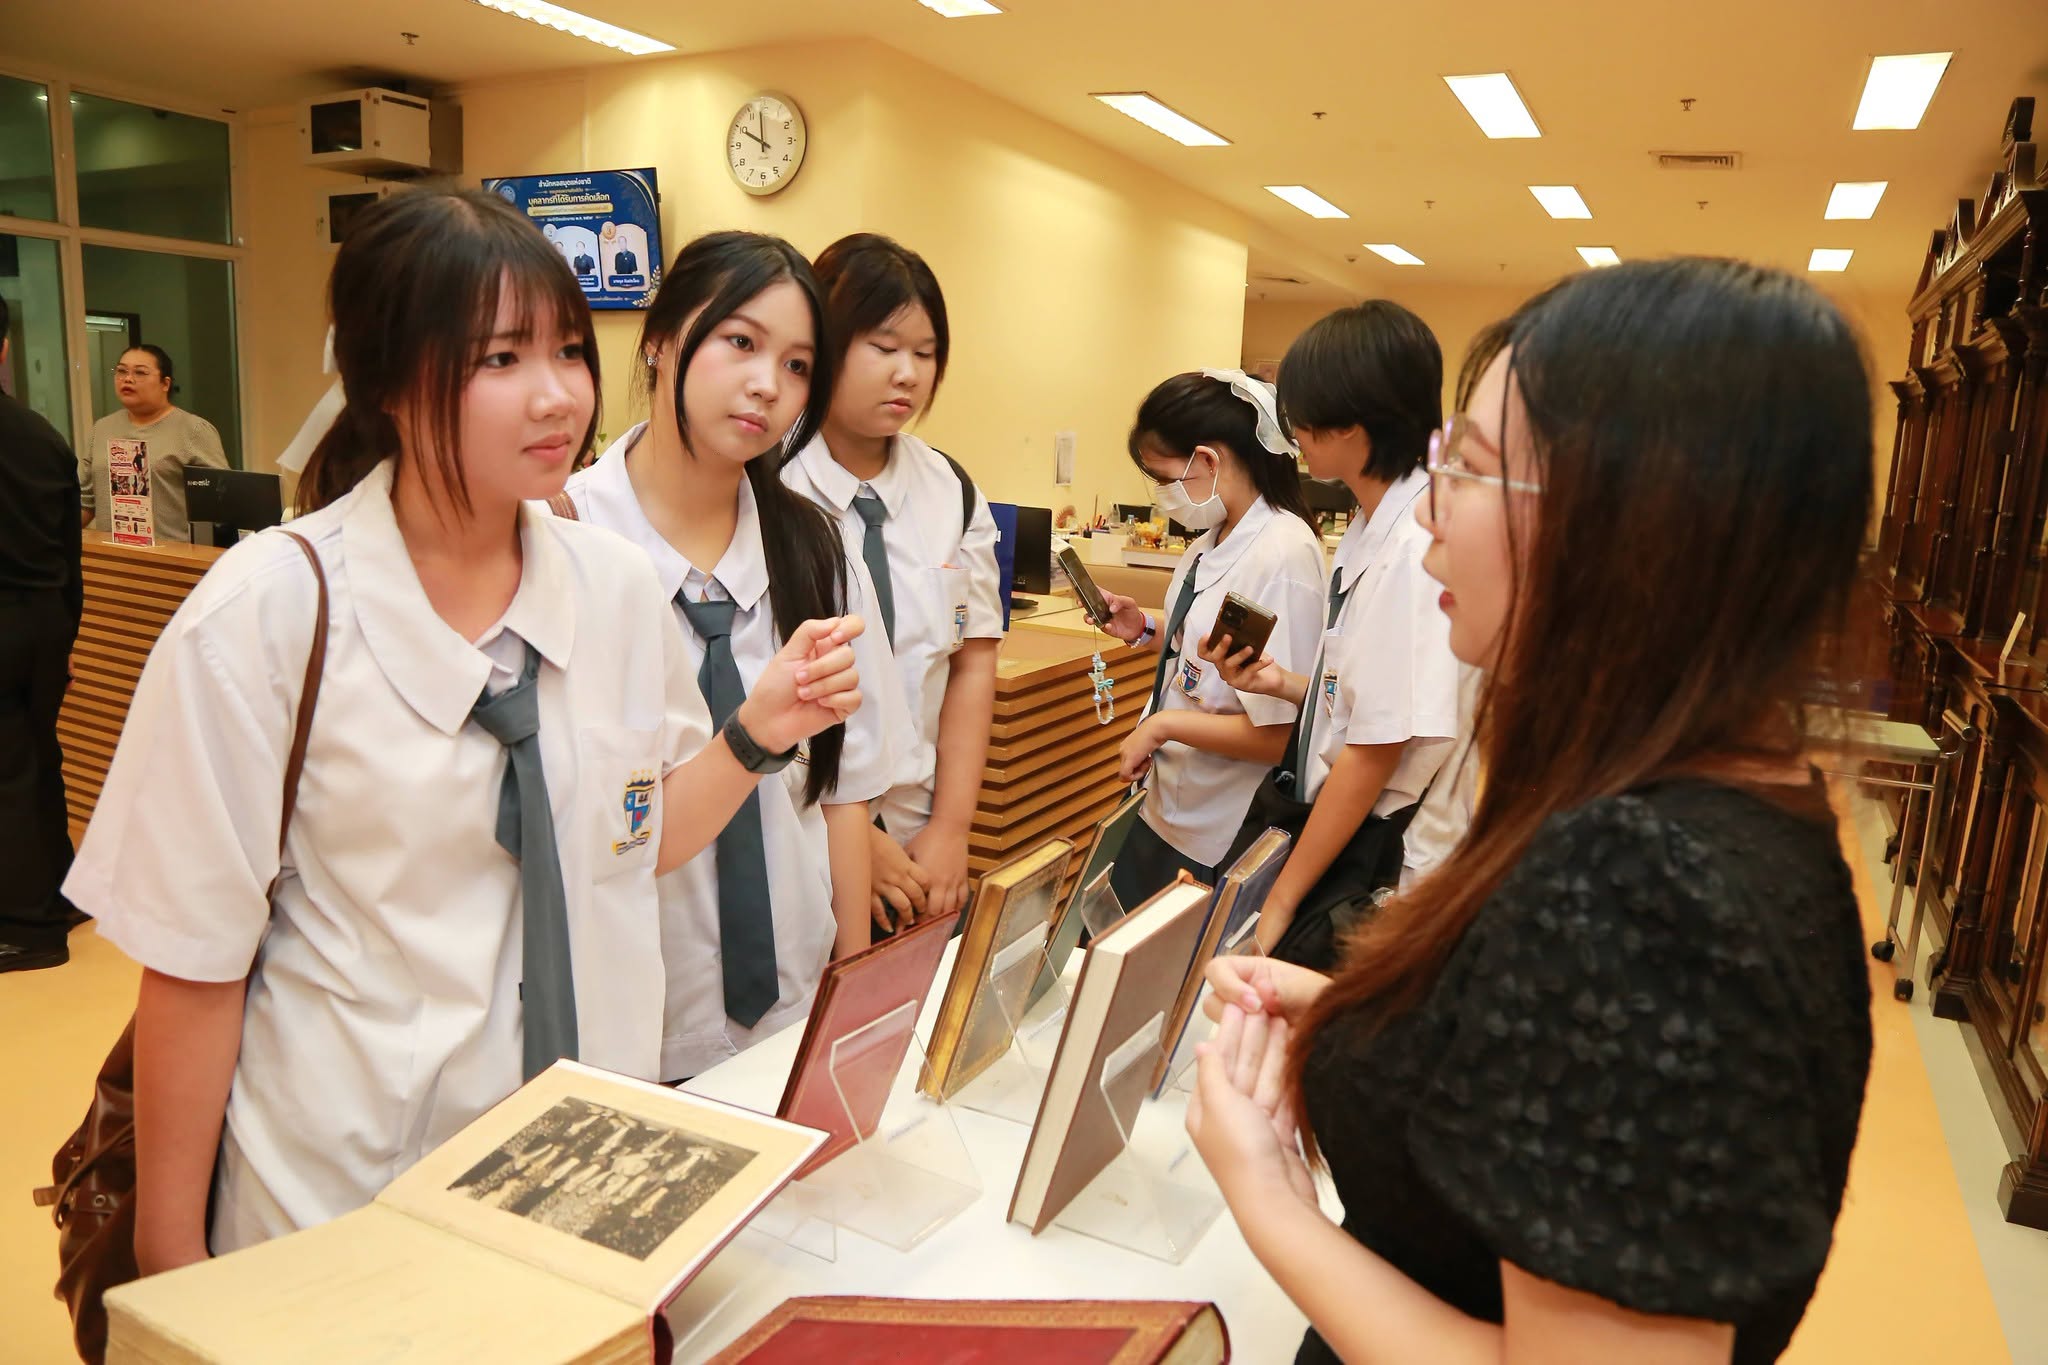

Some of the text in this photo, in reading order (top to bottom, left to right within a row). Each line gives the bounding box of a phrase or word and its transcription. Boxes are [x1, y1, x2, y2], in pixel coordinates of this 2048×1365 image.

[783, 121, 790, 129] 2
[739, 126, 748, 134] 10
[787, 137, 793, 145] 3
[739, 158, 746, 166] 8
[782, 154, 789, 162] 4
[749, 168, 755, 176] 7
[772, 166, 779, 174] 5
[760, 172, 767, 180] 6
[528, 192, 610, 207] บุคลากรที่ได้รับการคัดเลือก
